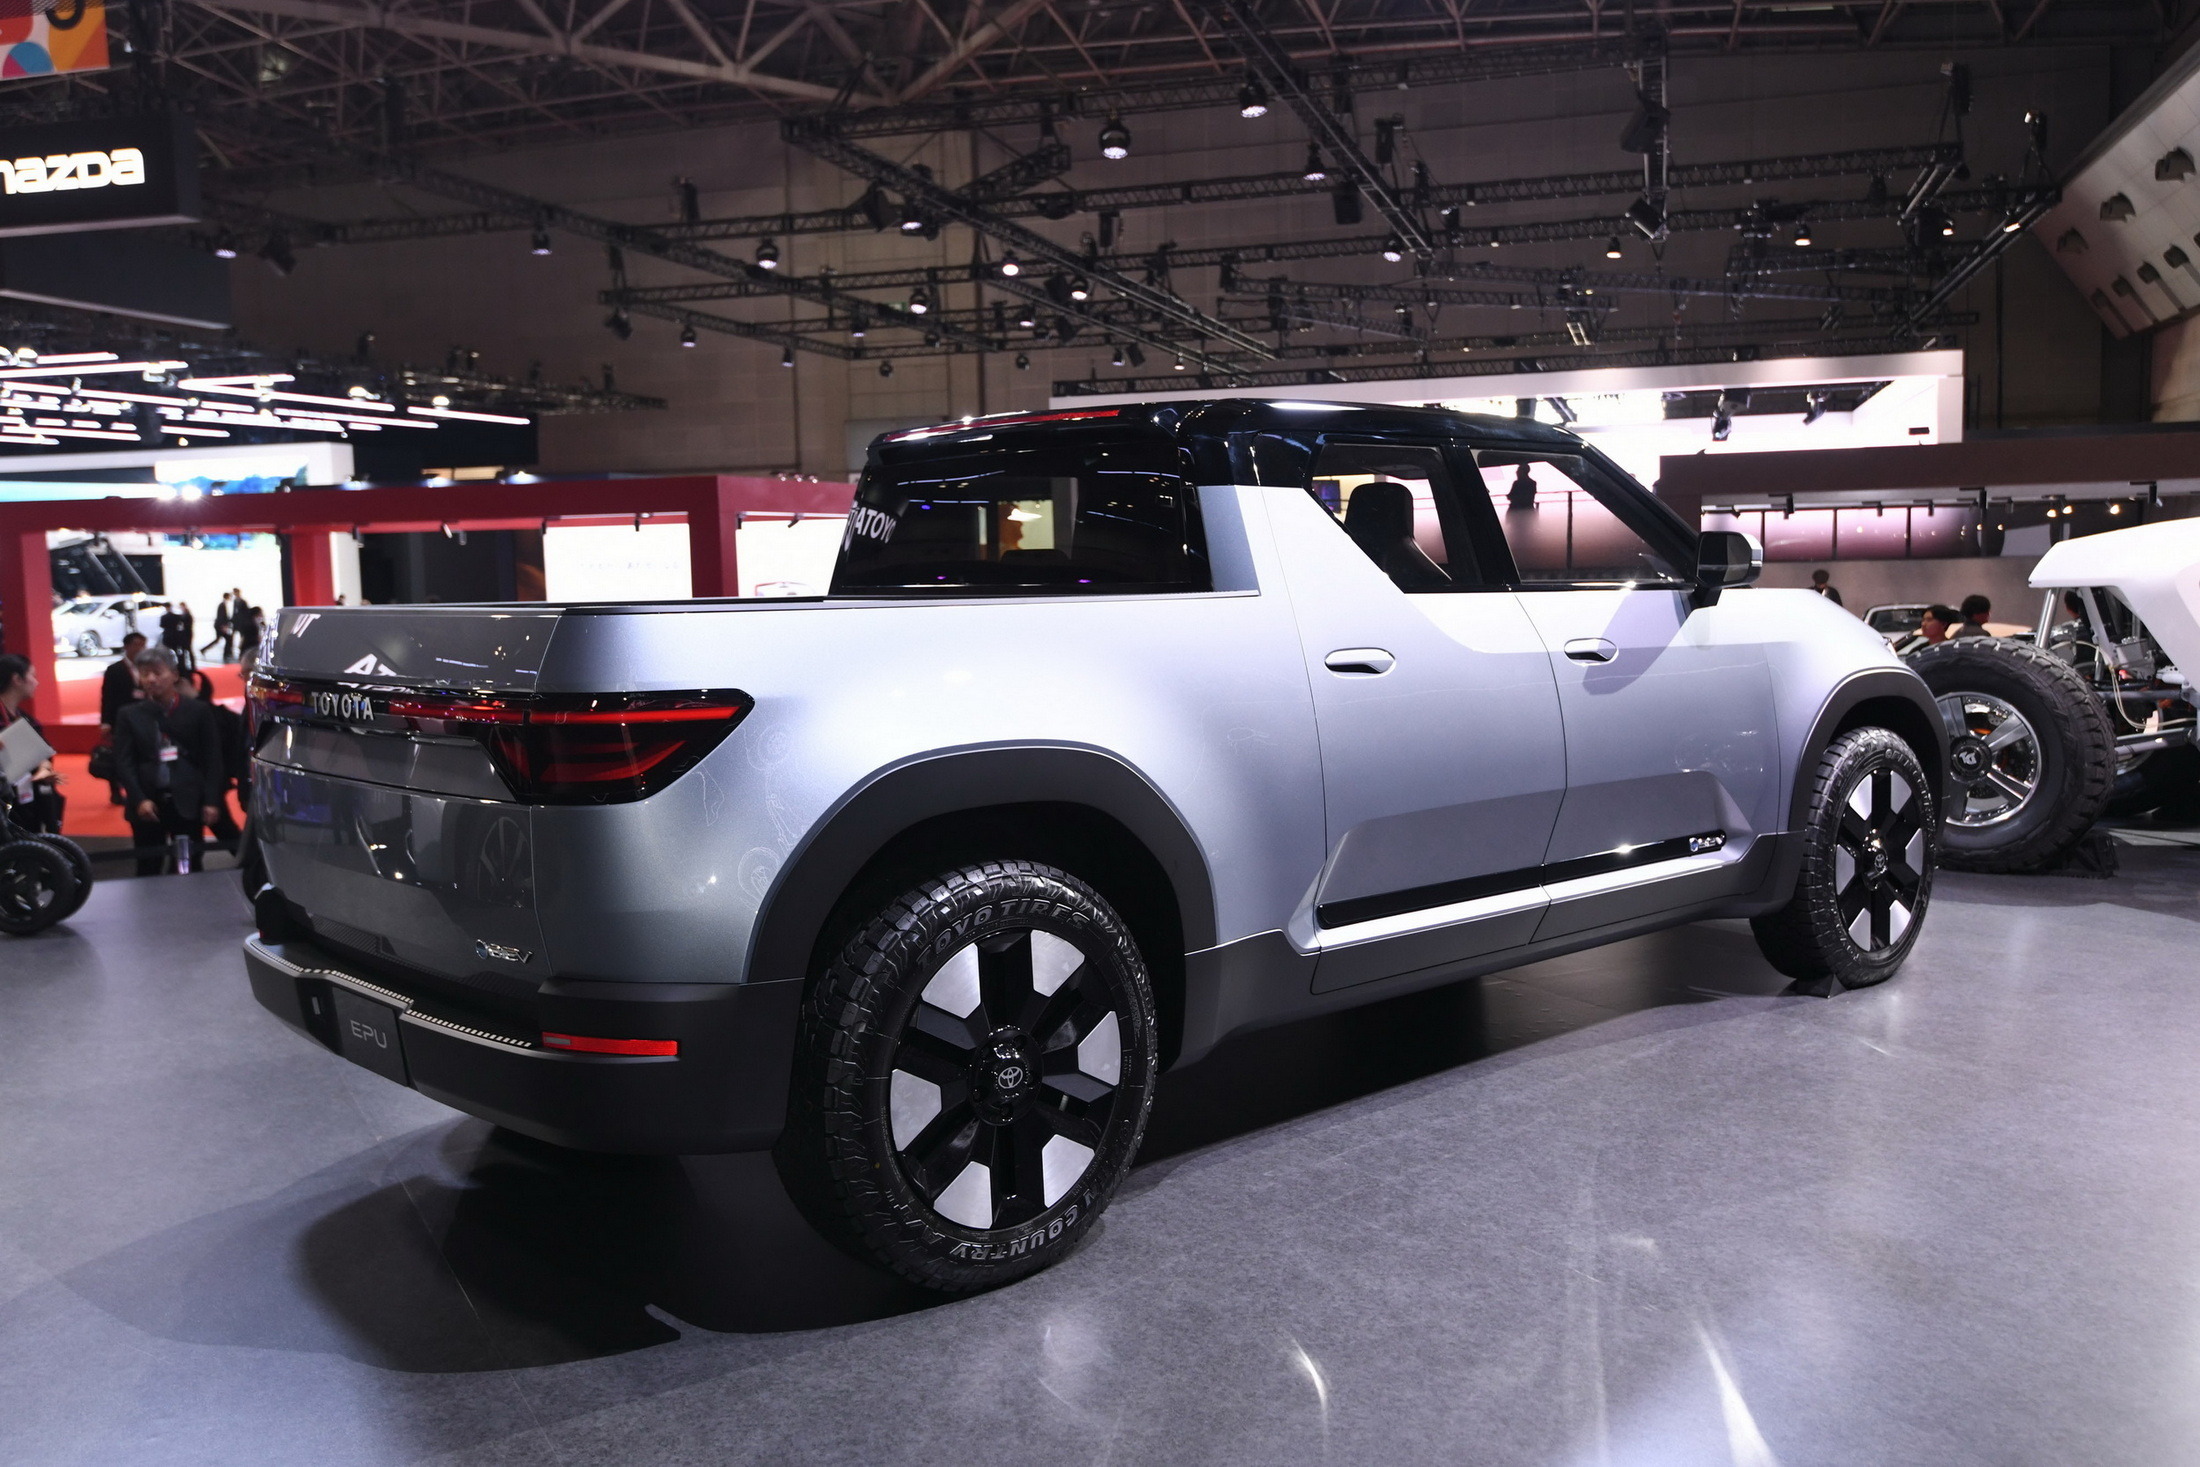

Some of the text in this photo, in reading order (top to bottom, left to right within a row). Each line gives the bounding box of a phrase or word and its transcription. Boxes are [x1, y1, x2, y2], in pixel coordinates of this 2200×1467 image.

[310, 691, 375, 721] TOYOTA
[1000, 898, 1091, 930] TIRES
[350, 1019, 388, 1049] EPU
[949, 1204, 1079, 1261] COUNTRY
